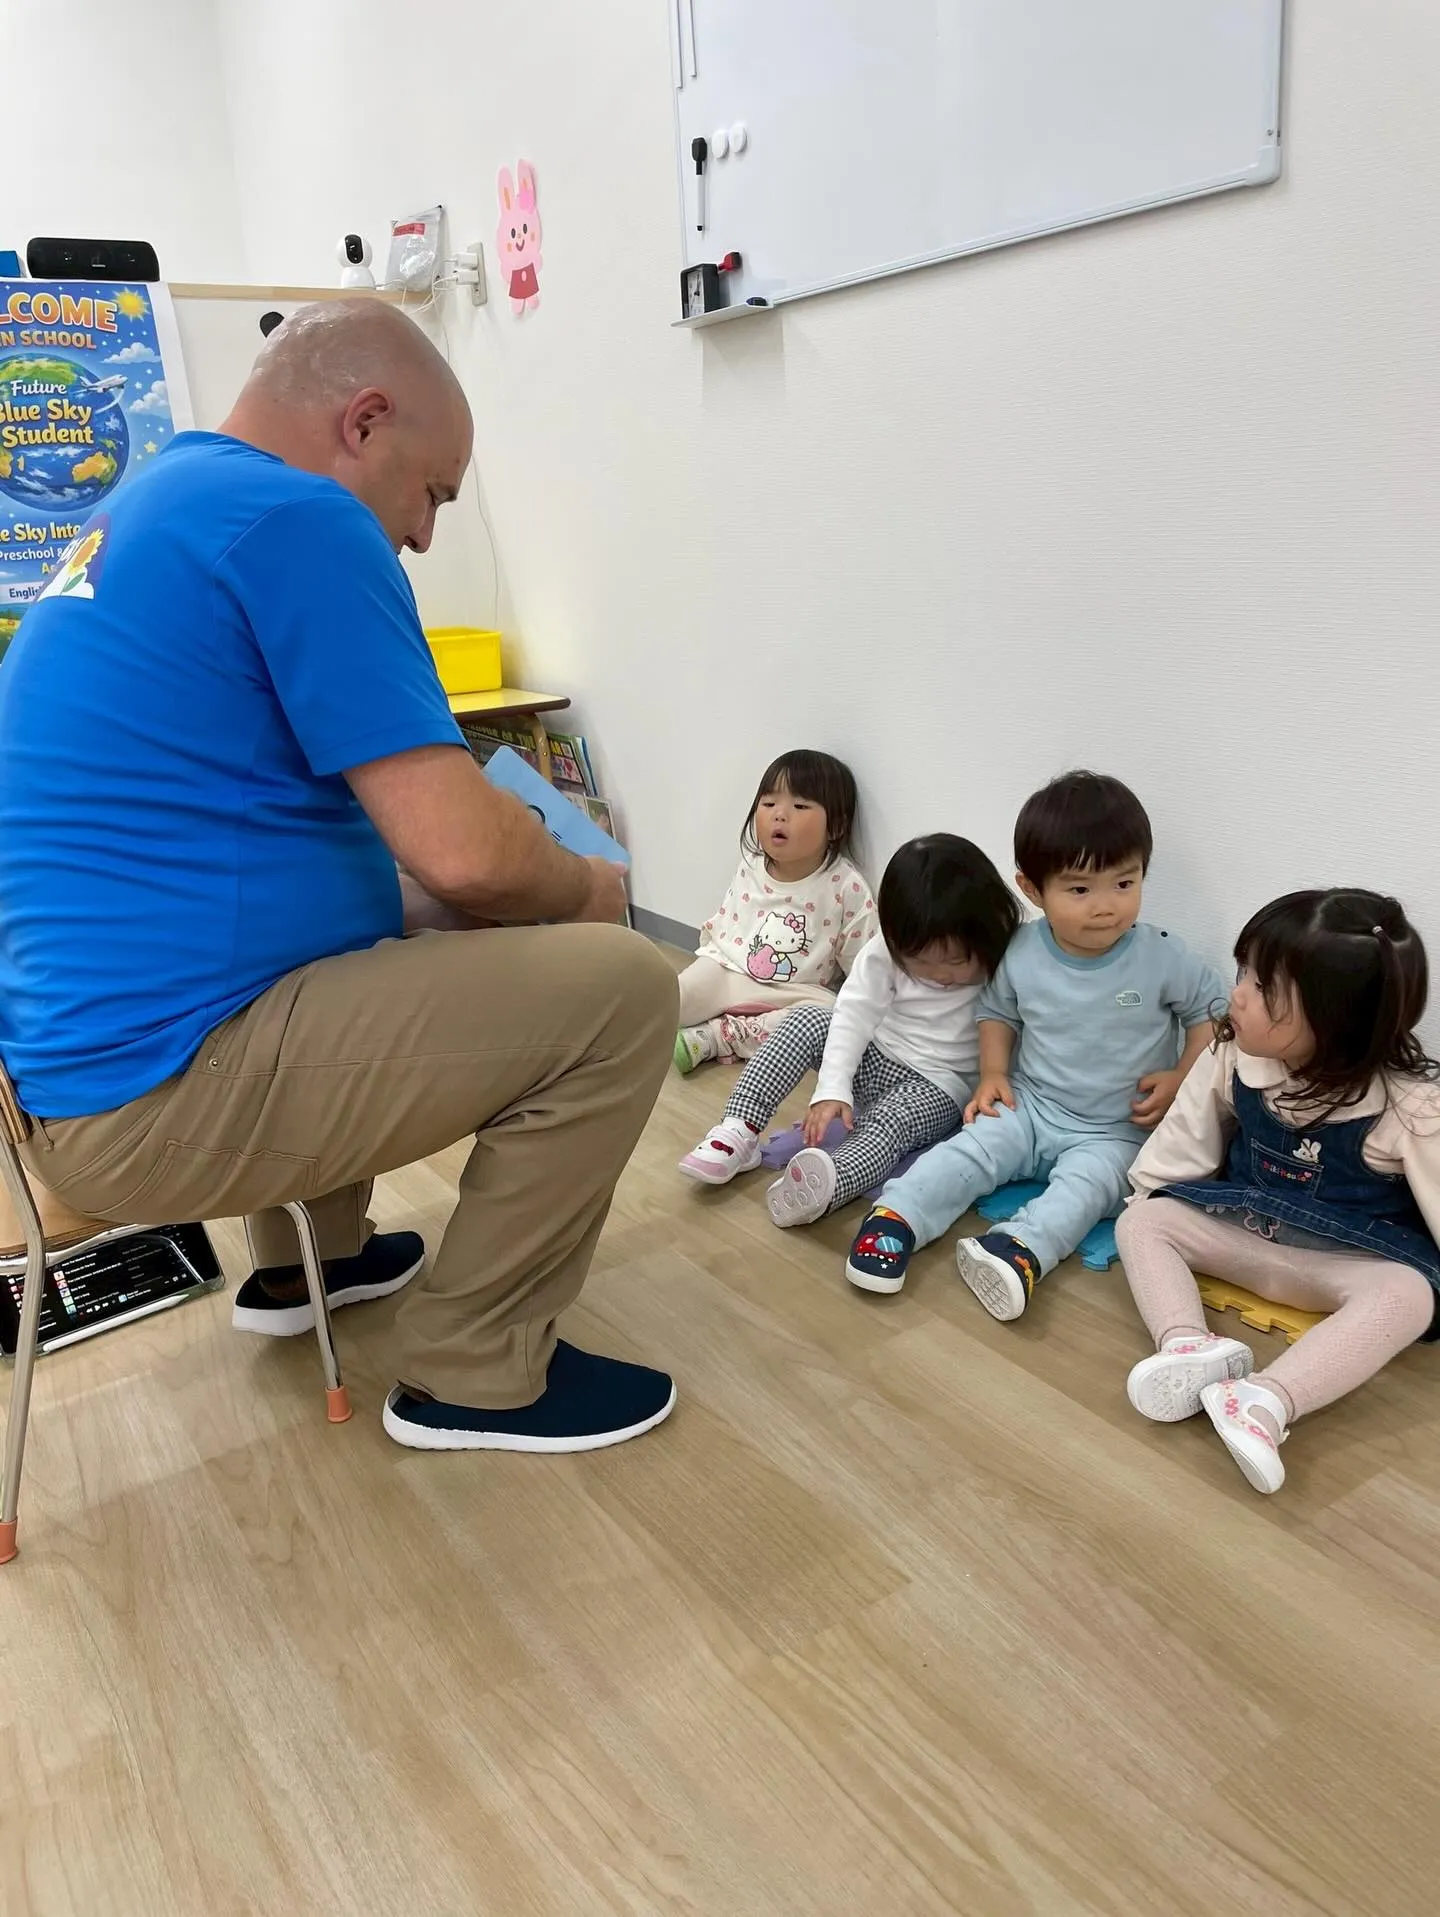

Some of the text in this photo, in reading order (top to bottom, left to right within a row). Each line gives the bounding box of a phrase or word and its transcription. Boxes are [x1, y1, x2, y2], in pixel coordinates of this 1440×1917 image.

[0, 330, 97, 349] N SCHOOL
[10, 380, 67, 396] Future
[47, 399, 92, 426] Sky
[2, 422, 94, 448] Student
[14, 523, 47, 544] Sky
[0, 546, 55, 561] reschool
[9, 586, 42, 599] Engli
